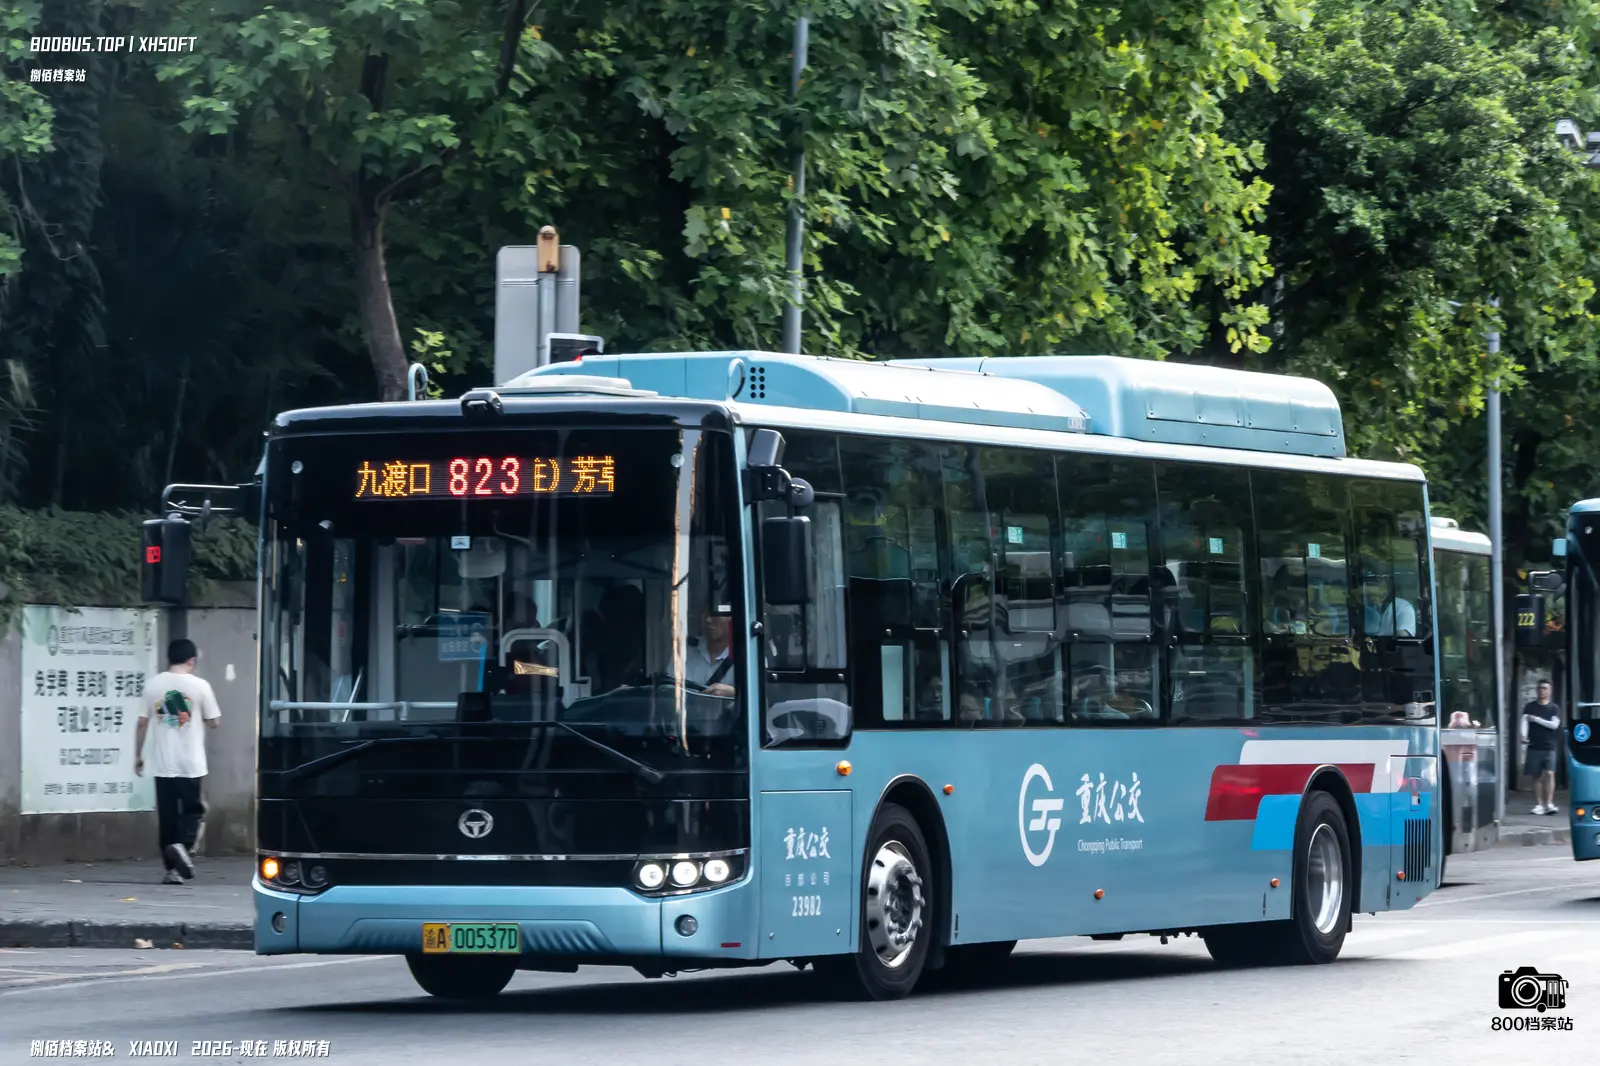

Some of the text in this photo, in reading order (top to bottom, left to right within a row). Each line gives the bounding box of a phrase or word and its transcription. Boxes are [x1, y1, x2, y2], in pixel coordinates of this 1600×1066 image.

[355, 460, 430, 497] 九渡口
[449, 456, 520, 496] 823
[1075, 772, 1145, 825] 重庆公交
[783, 826, 831, 860] 重庆公交
[792, 895, 822, 917] 23982
